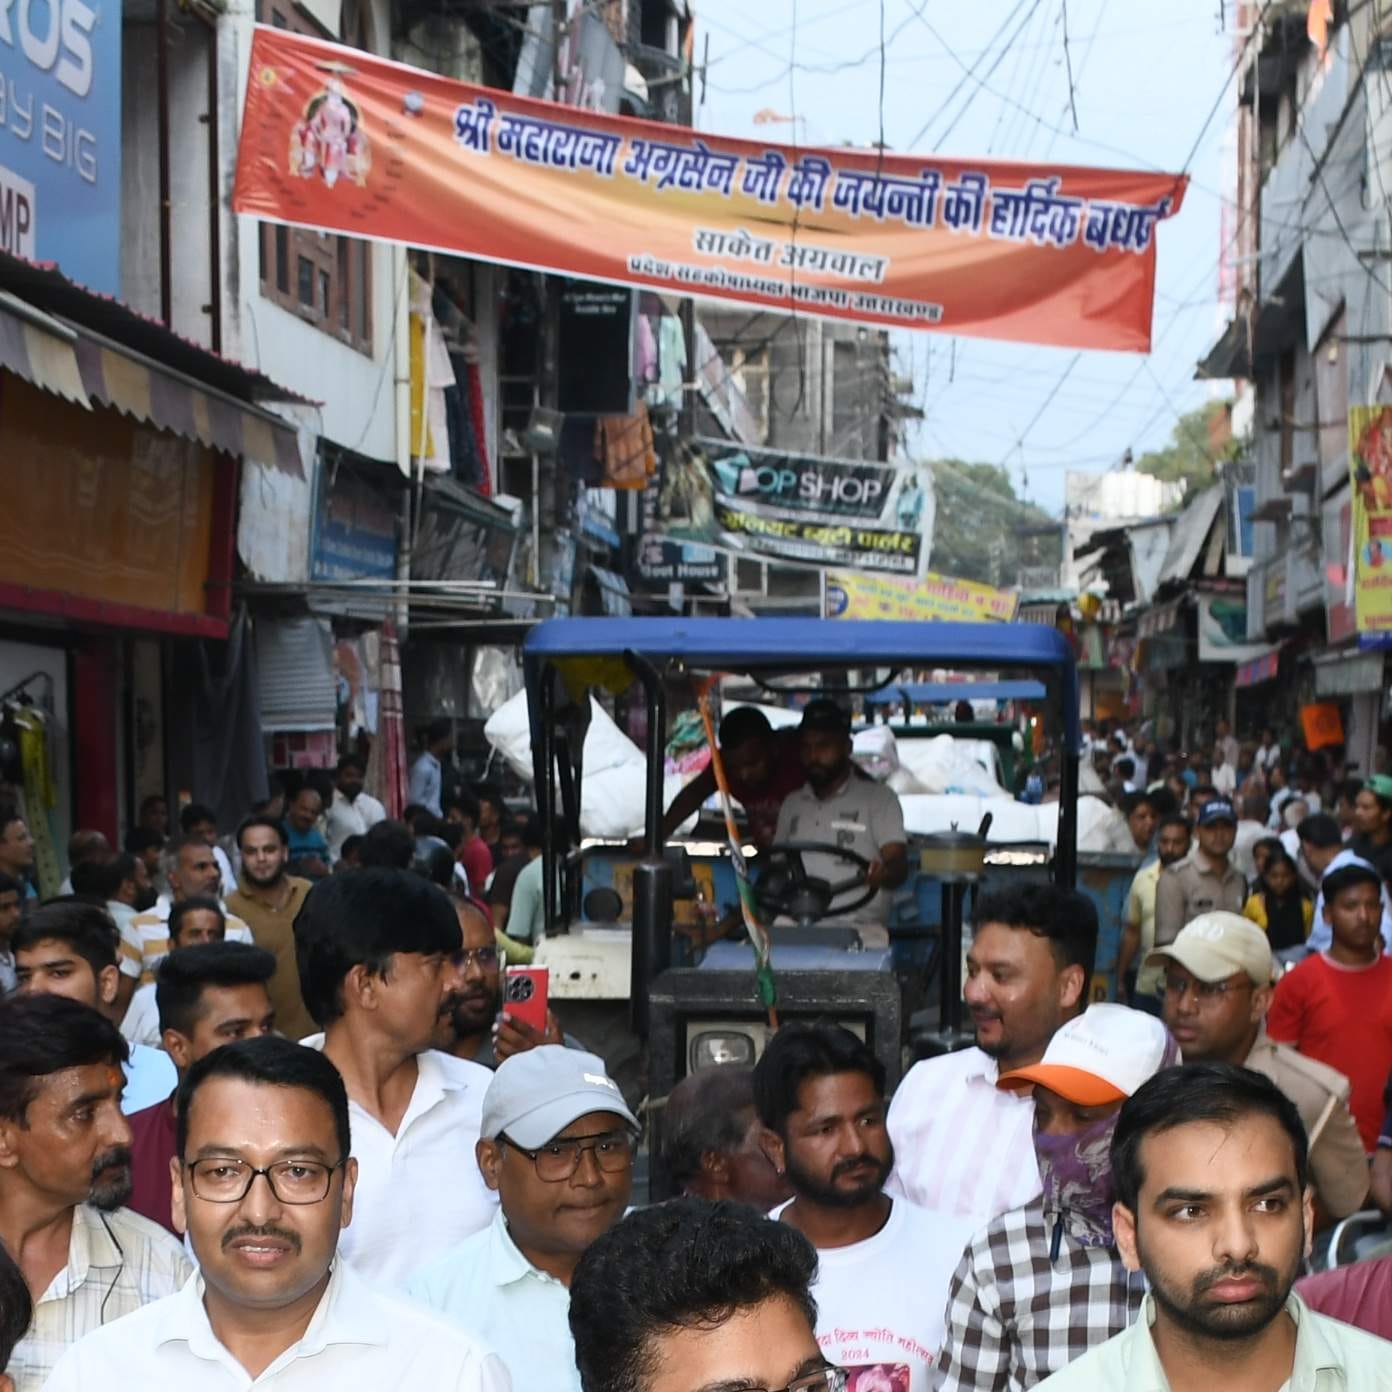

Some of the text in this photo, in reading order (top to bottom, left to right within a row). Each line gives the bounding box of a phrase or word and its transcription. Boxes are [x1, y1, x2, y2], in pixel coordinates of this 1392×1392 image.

[43, 103, 96, 183] BIG
[455, 100, 494, 153] श्री
[497, 116, 622, 174] महाराजा
[624, 139, 736, 196] अग्रसेन
[742, 152, 785, 204] जी
[788, 154, 832, 207] की
[833, 167, 939, 228] जयन्ती
[944, 172, 989, 231] की
[991, 178, 1082, 245] हार्दिक
[694, 229, 886, 281] साकेत अग्रवाल
[799, 471, 882, 504] SHOP
[841, 1348, 870, 1361] 2024
